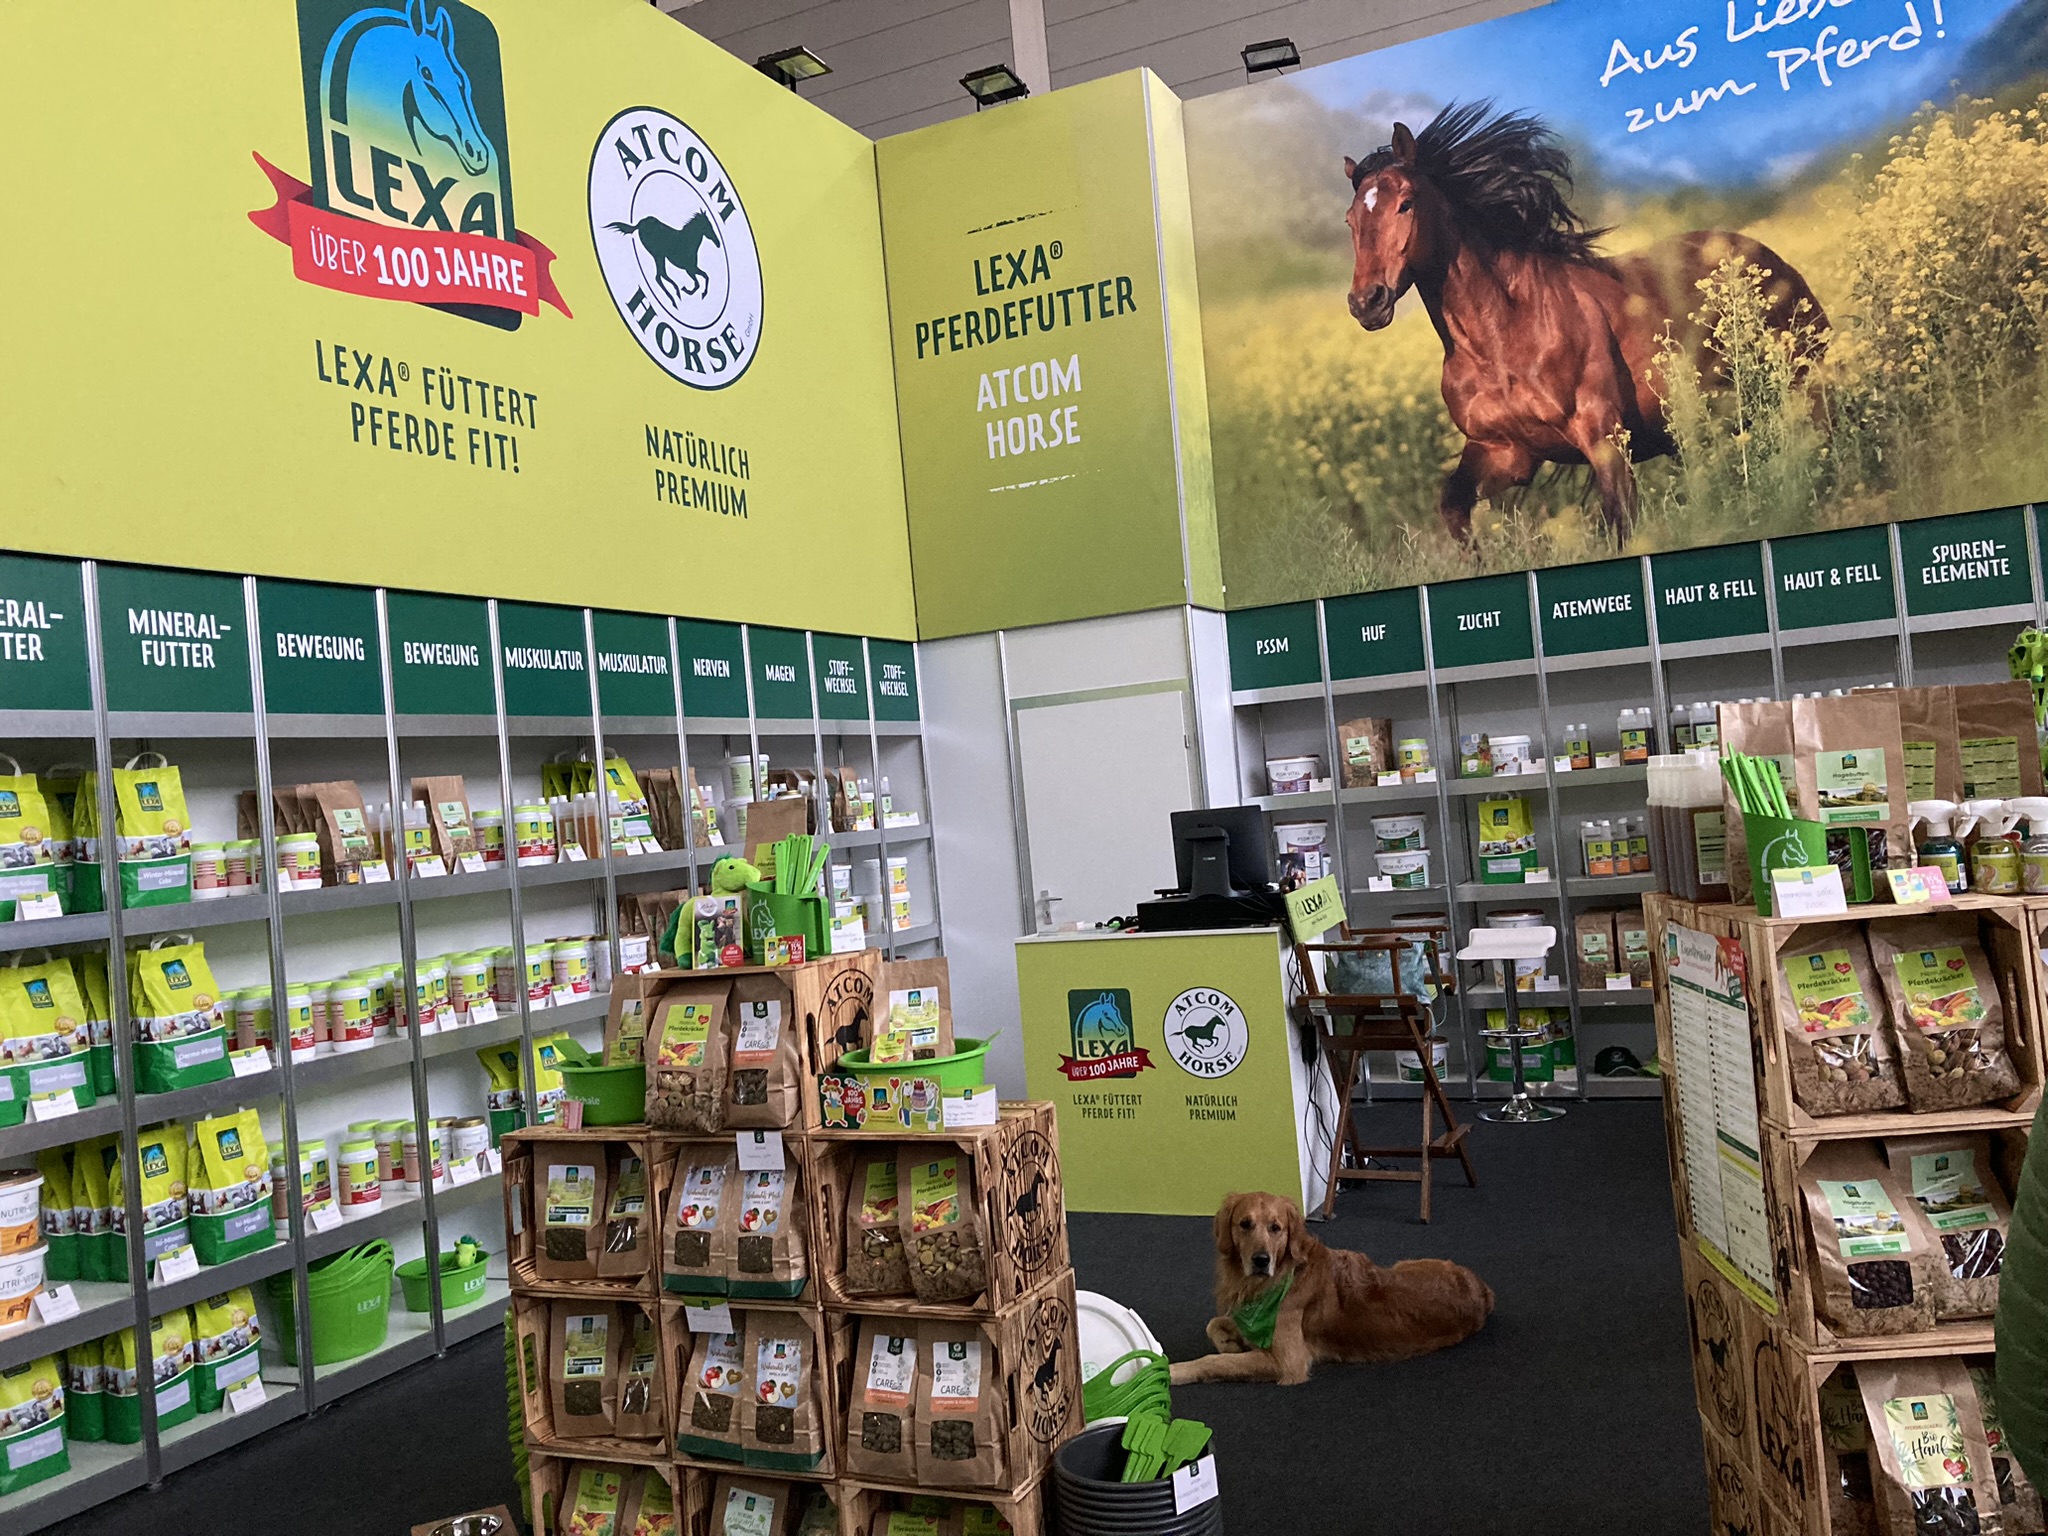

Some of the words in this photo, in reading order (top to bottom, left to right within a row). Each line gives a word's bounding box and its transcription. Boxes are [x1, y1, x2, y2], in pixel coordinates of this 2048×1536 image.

[1599, 26, 1699, 88] Aus
[1624, 82, 1757, 133] zum
[1767, 0, 1946, 91] Pferd!
[327, 129, 497, 238] LEXA
[613, 123, 737, 228] ATCOM
[308, 226, 367, 277] ÜBER
[372, 246, 430, 288] 100
[435, 247, 528, 298] JAHRE
[974, 240, 1063, 296] LEXA®
[914, 275, 1137, 360] PFERDEFUTTER
[624, 285, 747, 376] HORSE
[315, 339, 411, 398] LEXA®
[422, 366, 538, 430] FÜTTERT
[976, 353, 1082, 412] ATCOM
[350, 401, 457, 462] PFERDE
[467, 427, 521, 474] FIT!
[986, 405, 1081, 460] HORSE
[644, 424, 750, 481] NATÜRLICH
[655, 469, 748, 520] PREMIUM
[1931, 539, 2006, 564] SPUREN-
[1784, 570, 1825, 591] HAUT
[1830, 569, 1841, 586] &
[1845, 563, 1881, 583] FELL
[1921, 558, 2011, 585] ELEMENTE
[1665, 584, 1704, 605] HAUT
[1708, 583, 1720, 600] &
[1723, 579, 1757, 599] FELL
[1552, 594, 1632, 620] ATEMWEGE
[128, 607, 231, 640] MINERAL-
[1361, 624, 1387, 642] HUF
[1457, 610, 1502, 632] ZUCHT
[141, 639, 216, 669] FUTTER
[276, 632, 365, 661] BEWEGUNG
[403, 641, 479, 667] BEWEGUNG
[1256, 637, 1289, 656] PSSM
[505, 646, 584, 672] MUSKULATUR
[599, 651, 668, 676] MUSKULATUR
[693, 657, 730, 678] NERVEN
[828, 659, 854, 677] STOFF-
[765, 663, 796, 683] MAGEN
[883, 663, 906, 680] STOFF-
[824, 676, 857, 695] WECHSEL
[879, 679, 909, 697] WECHSEL
[1832, 769, 1870, 779] Hagebutten
[0, 804, 18, 812] EXA
[1301, 893, 1325, 916] LEXA
[1796, 976, 1851, 990] Pferdekräcker
[1907, 972, 1965, 987] Pferdekräcker
[1174, 991, 1235, 1017] ATCOM
[1077, 1039, 1130, 1058] LEXA
[1071, 1065, 1088, 1077] ÜBER
[1089, 1061, 1106, 1076] 100
[1107, 1057, 1139, 1073] JAHRE
[1178, 1050, 1237, 1074] HORSE
[1103, 1093, 1142, 1106] FÜTTERT
[1185, 1093, 1238, 1107] NATÜRLICH
[1082, 1107, 1114, 1119] PFERDE
[1117, 1107, 1136, 1119] FIT!
[1189, 1108, 1236, 1121] PREMIUM
[0, 1272, 41, 1291] UTRI-VITAL
[463, 1275, 486, 1292] LEXA
[357, 1295, 381, 1313] LEXA
[940, 1385, 960, 1395] CARE
[1911, 1437, 1950, 1460] Hanf
[1922, 1431, 1938, 1443] Bio
